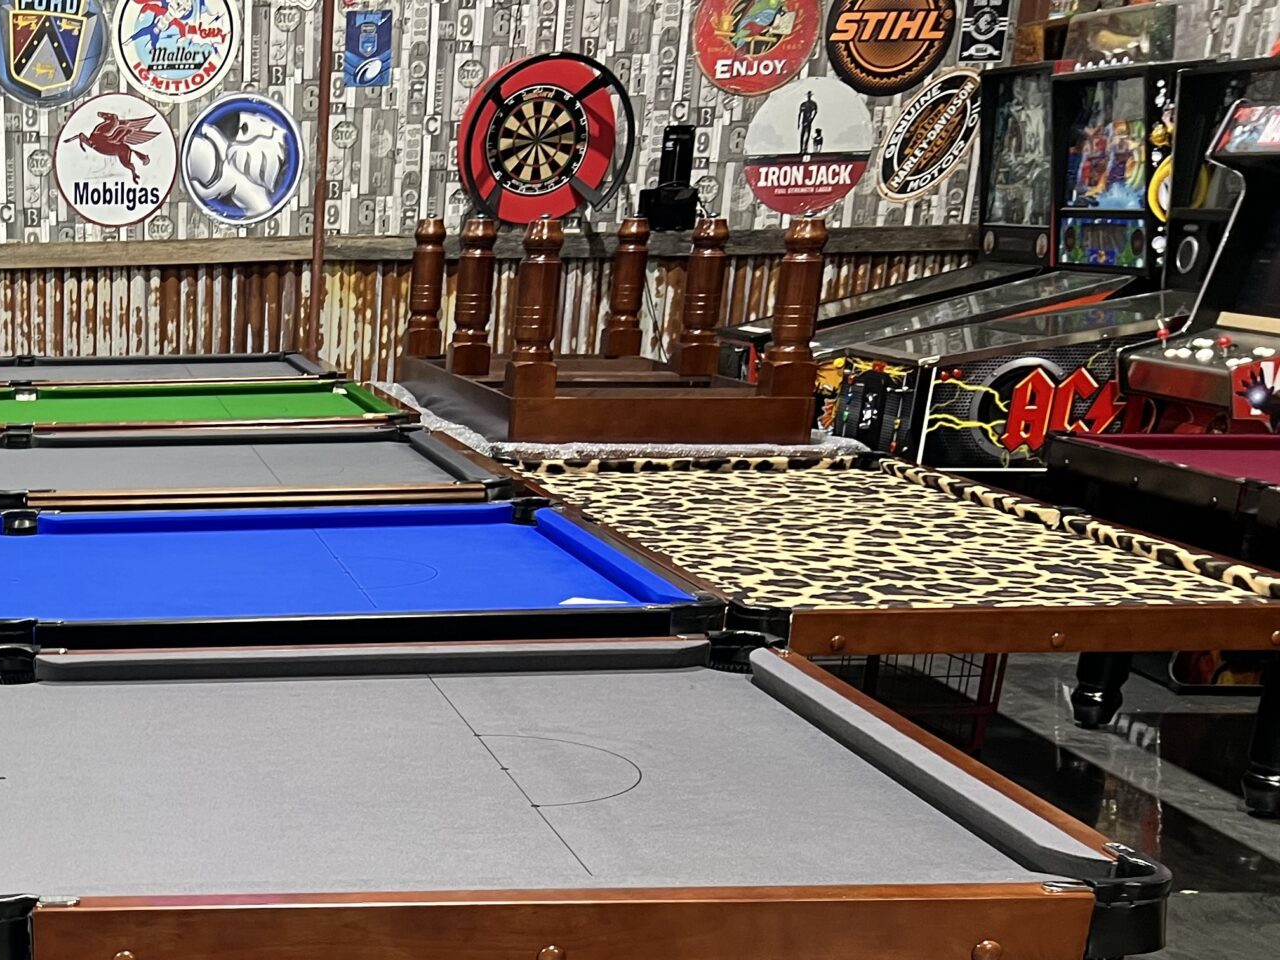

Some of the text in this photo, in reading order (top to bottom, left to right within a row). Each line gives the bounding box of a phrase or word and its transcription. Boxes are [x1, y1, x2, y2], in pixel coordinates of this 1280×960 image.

[829, 11, 945, 42] STIHL
[149, 47, 212, 63] Mallory
[133, 60, 218, 92] IGNITION
[885, 82, 943, 159] GENUINE
[890, 81, 976, 188] HARLEY-DAVIDSON
[906, 97, 982, 192] MOTOR OIL
[757, 164, 854, 187] IRON JACK
[74, 181, 161, 211] Mobilgas
